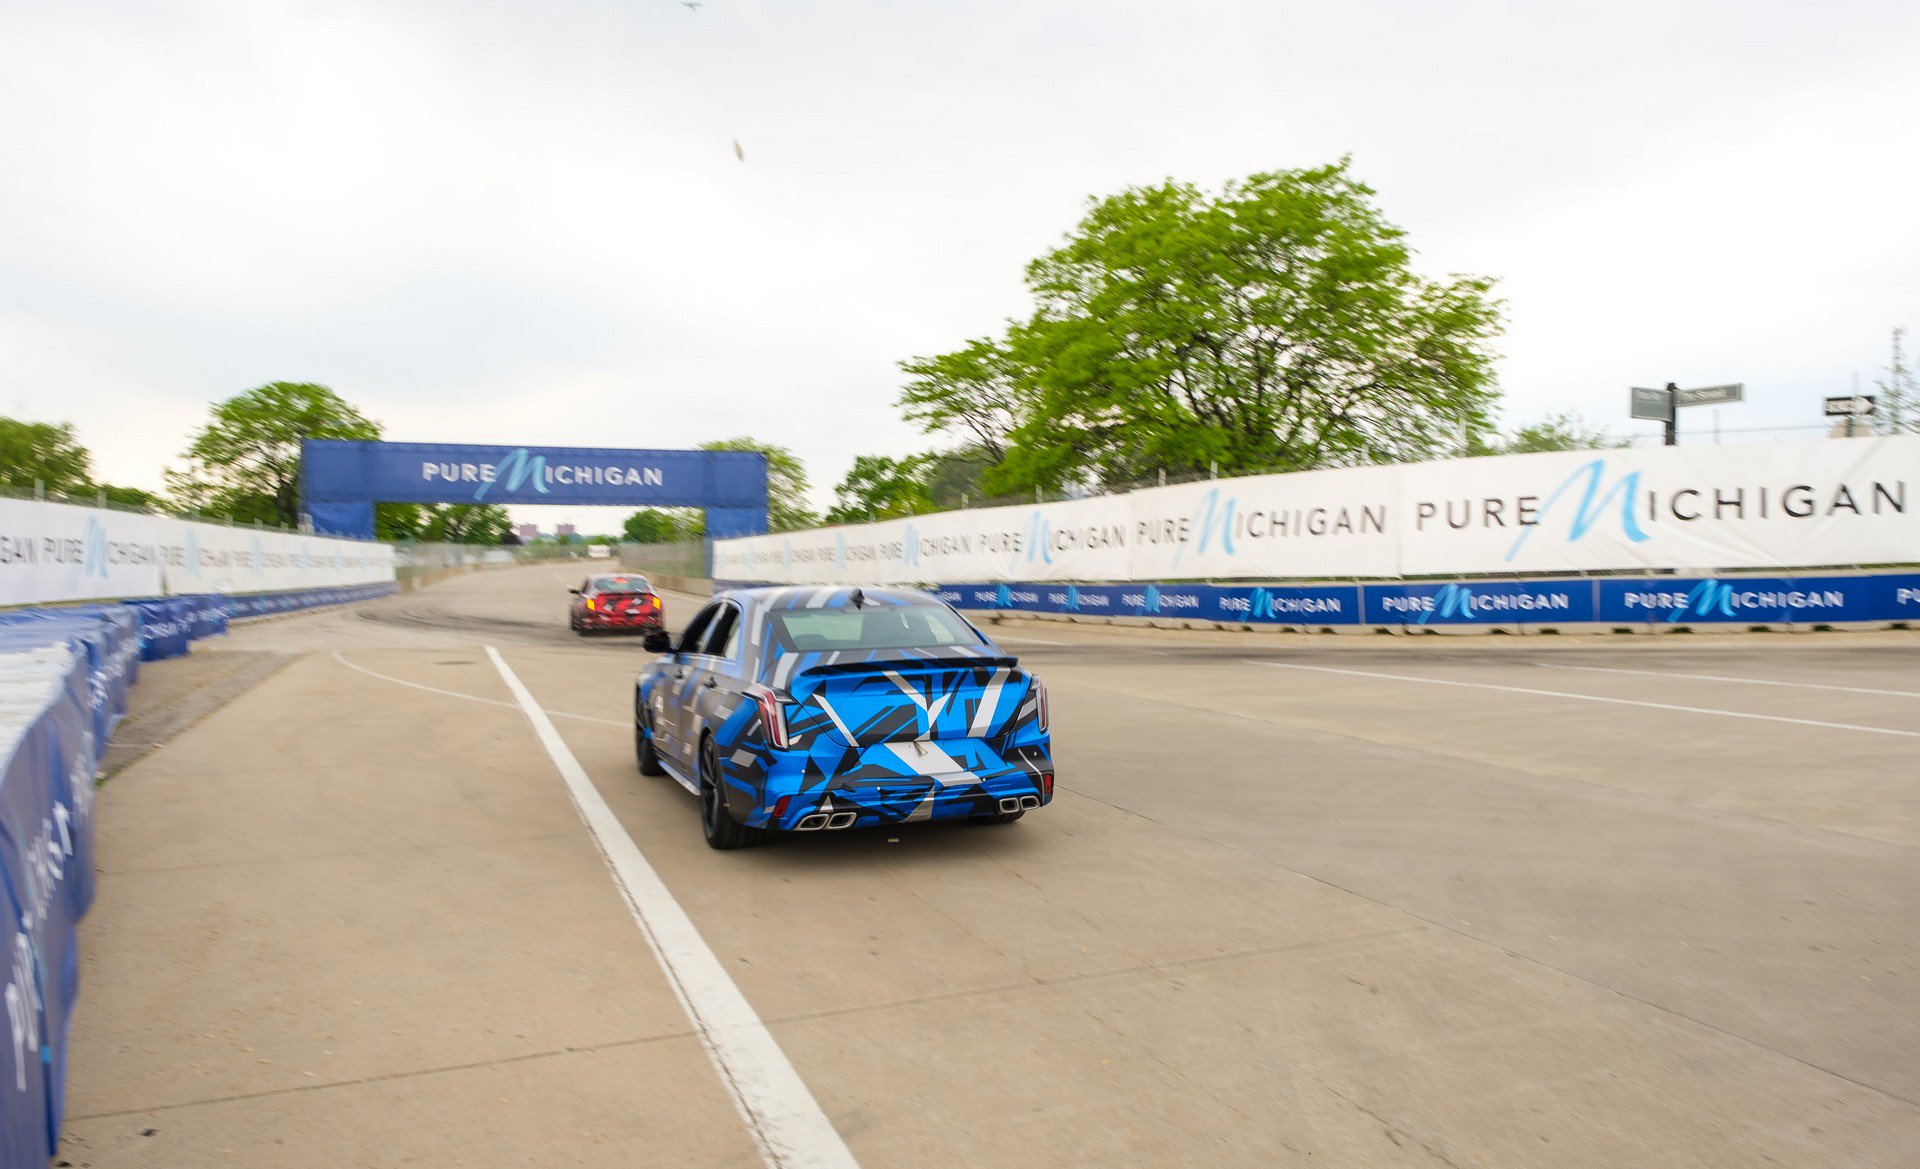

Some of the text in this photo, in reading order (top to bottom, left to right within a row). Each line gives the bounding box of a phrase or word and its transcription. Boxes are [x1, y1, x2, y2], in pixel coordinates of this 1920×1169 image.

[421, 447, 664, 500] PURE MICHIGAN
[1136, 486, 1387, 571] PURE MICHIGAN
[1416, 457, 1907, 563] PURE MICHIGAN
[980, 509, 1126, 575] PURE MICHIGAN
[1121, 583, 1200, 616] PURE MICHIGAN
[1219, 585, 1342, 622] PURE MICHIGAN
[1383, 582, 1569, 625] PURE MICHIGAN
[1624, 578, 1843, 623] PURE MICHIGAN
